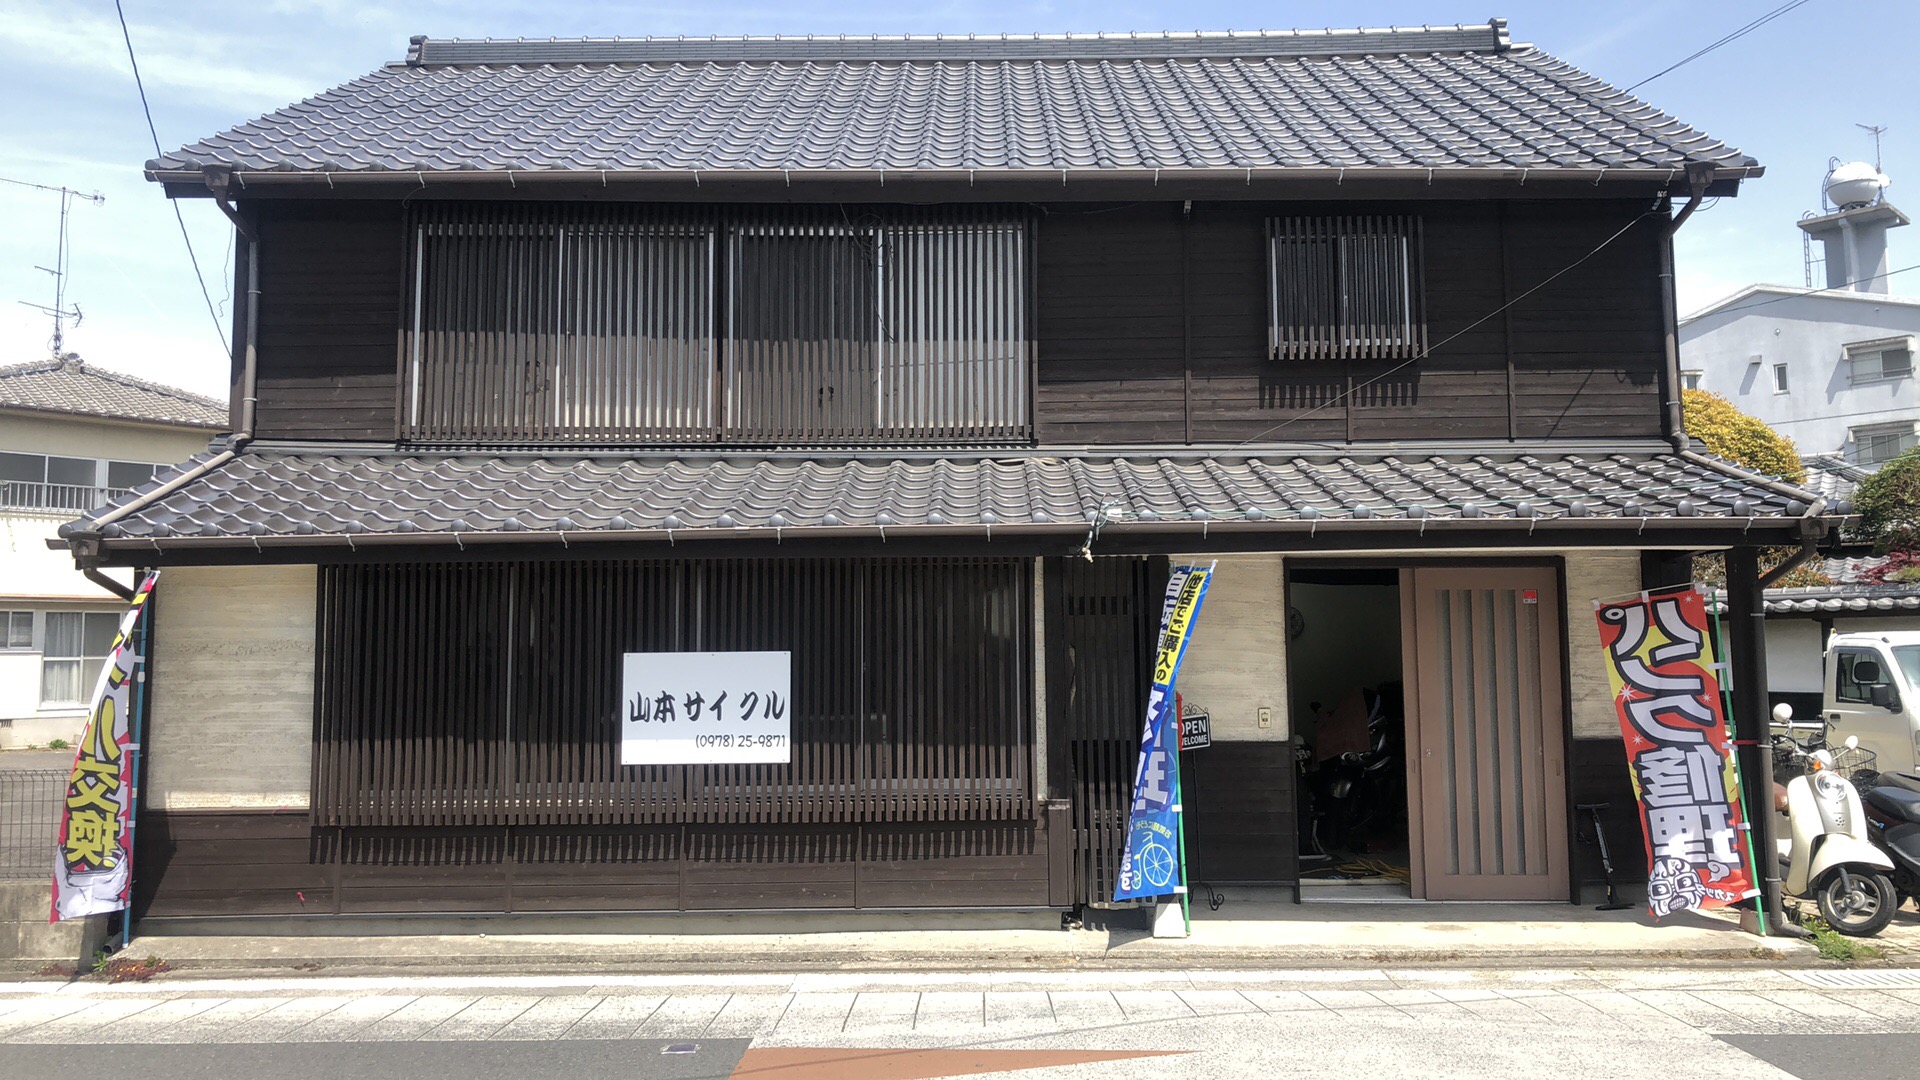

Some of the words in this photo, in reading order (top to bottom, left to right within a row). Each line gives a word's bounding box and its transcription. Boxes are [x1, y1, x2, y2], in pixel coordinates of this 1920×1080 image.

[1156, 573, 1204, 681] 他店でご購入の
[630, 690, 785, 723] 山本サイクル
[695, 734, 734, 748] (0978)
[738, 734, 785, 748] 25-9871
[1181, 734, 1208, 746] ELCOME
